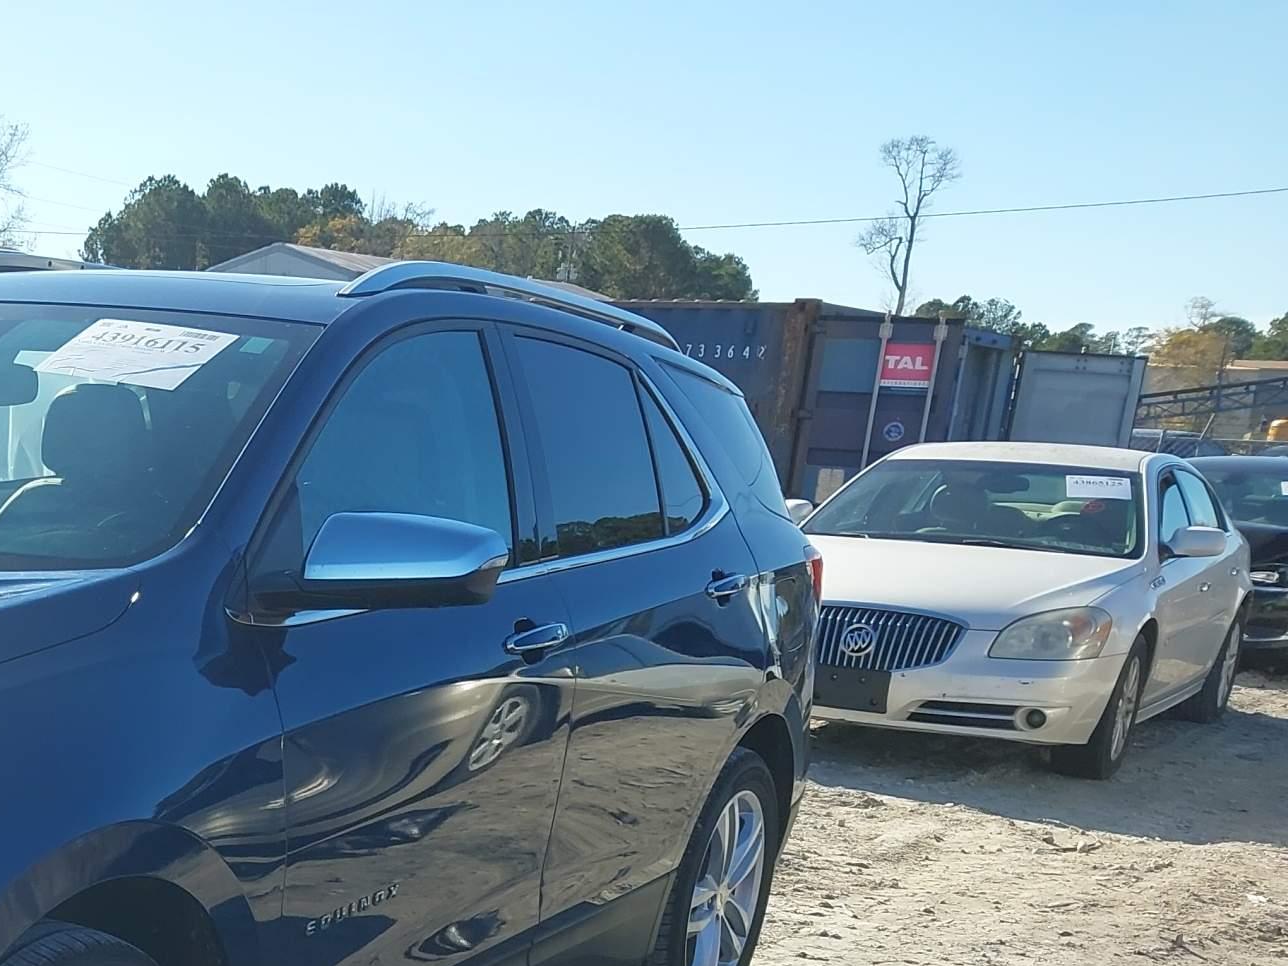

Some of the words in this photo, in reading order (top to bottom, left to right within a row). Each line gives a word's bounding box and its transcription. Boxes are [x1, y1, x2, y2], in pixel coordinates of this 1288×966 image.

[92, 331, 207, 354] 43916115
[884, 355, 929, 370] TAL
[305, 883, 400, 936] EQUINOX
